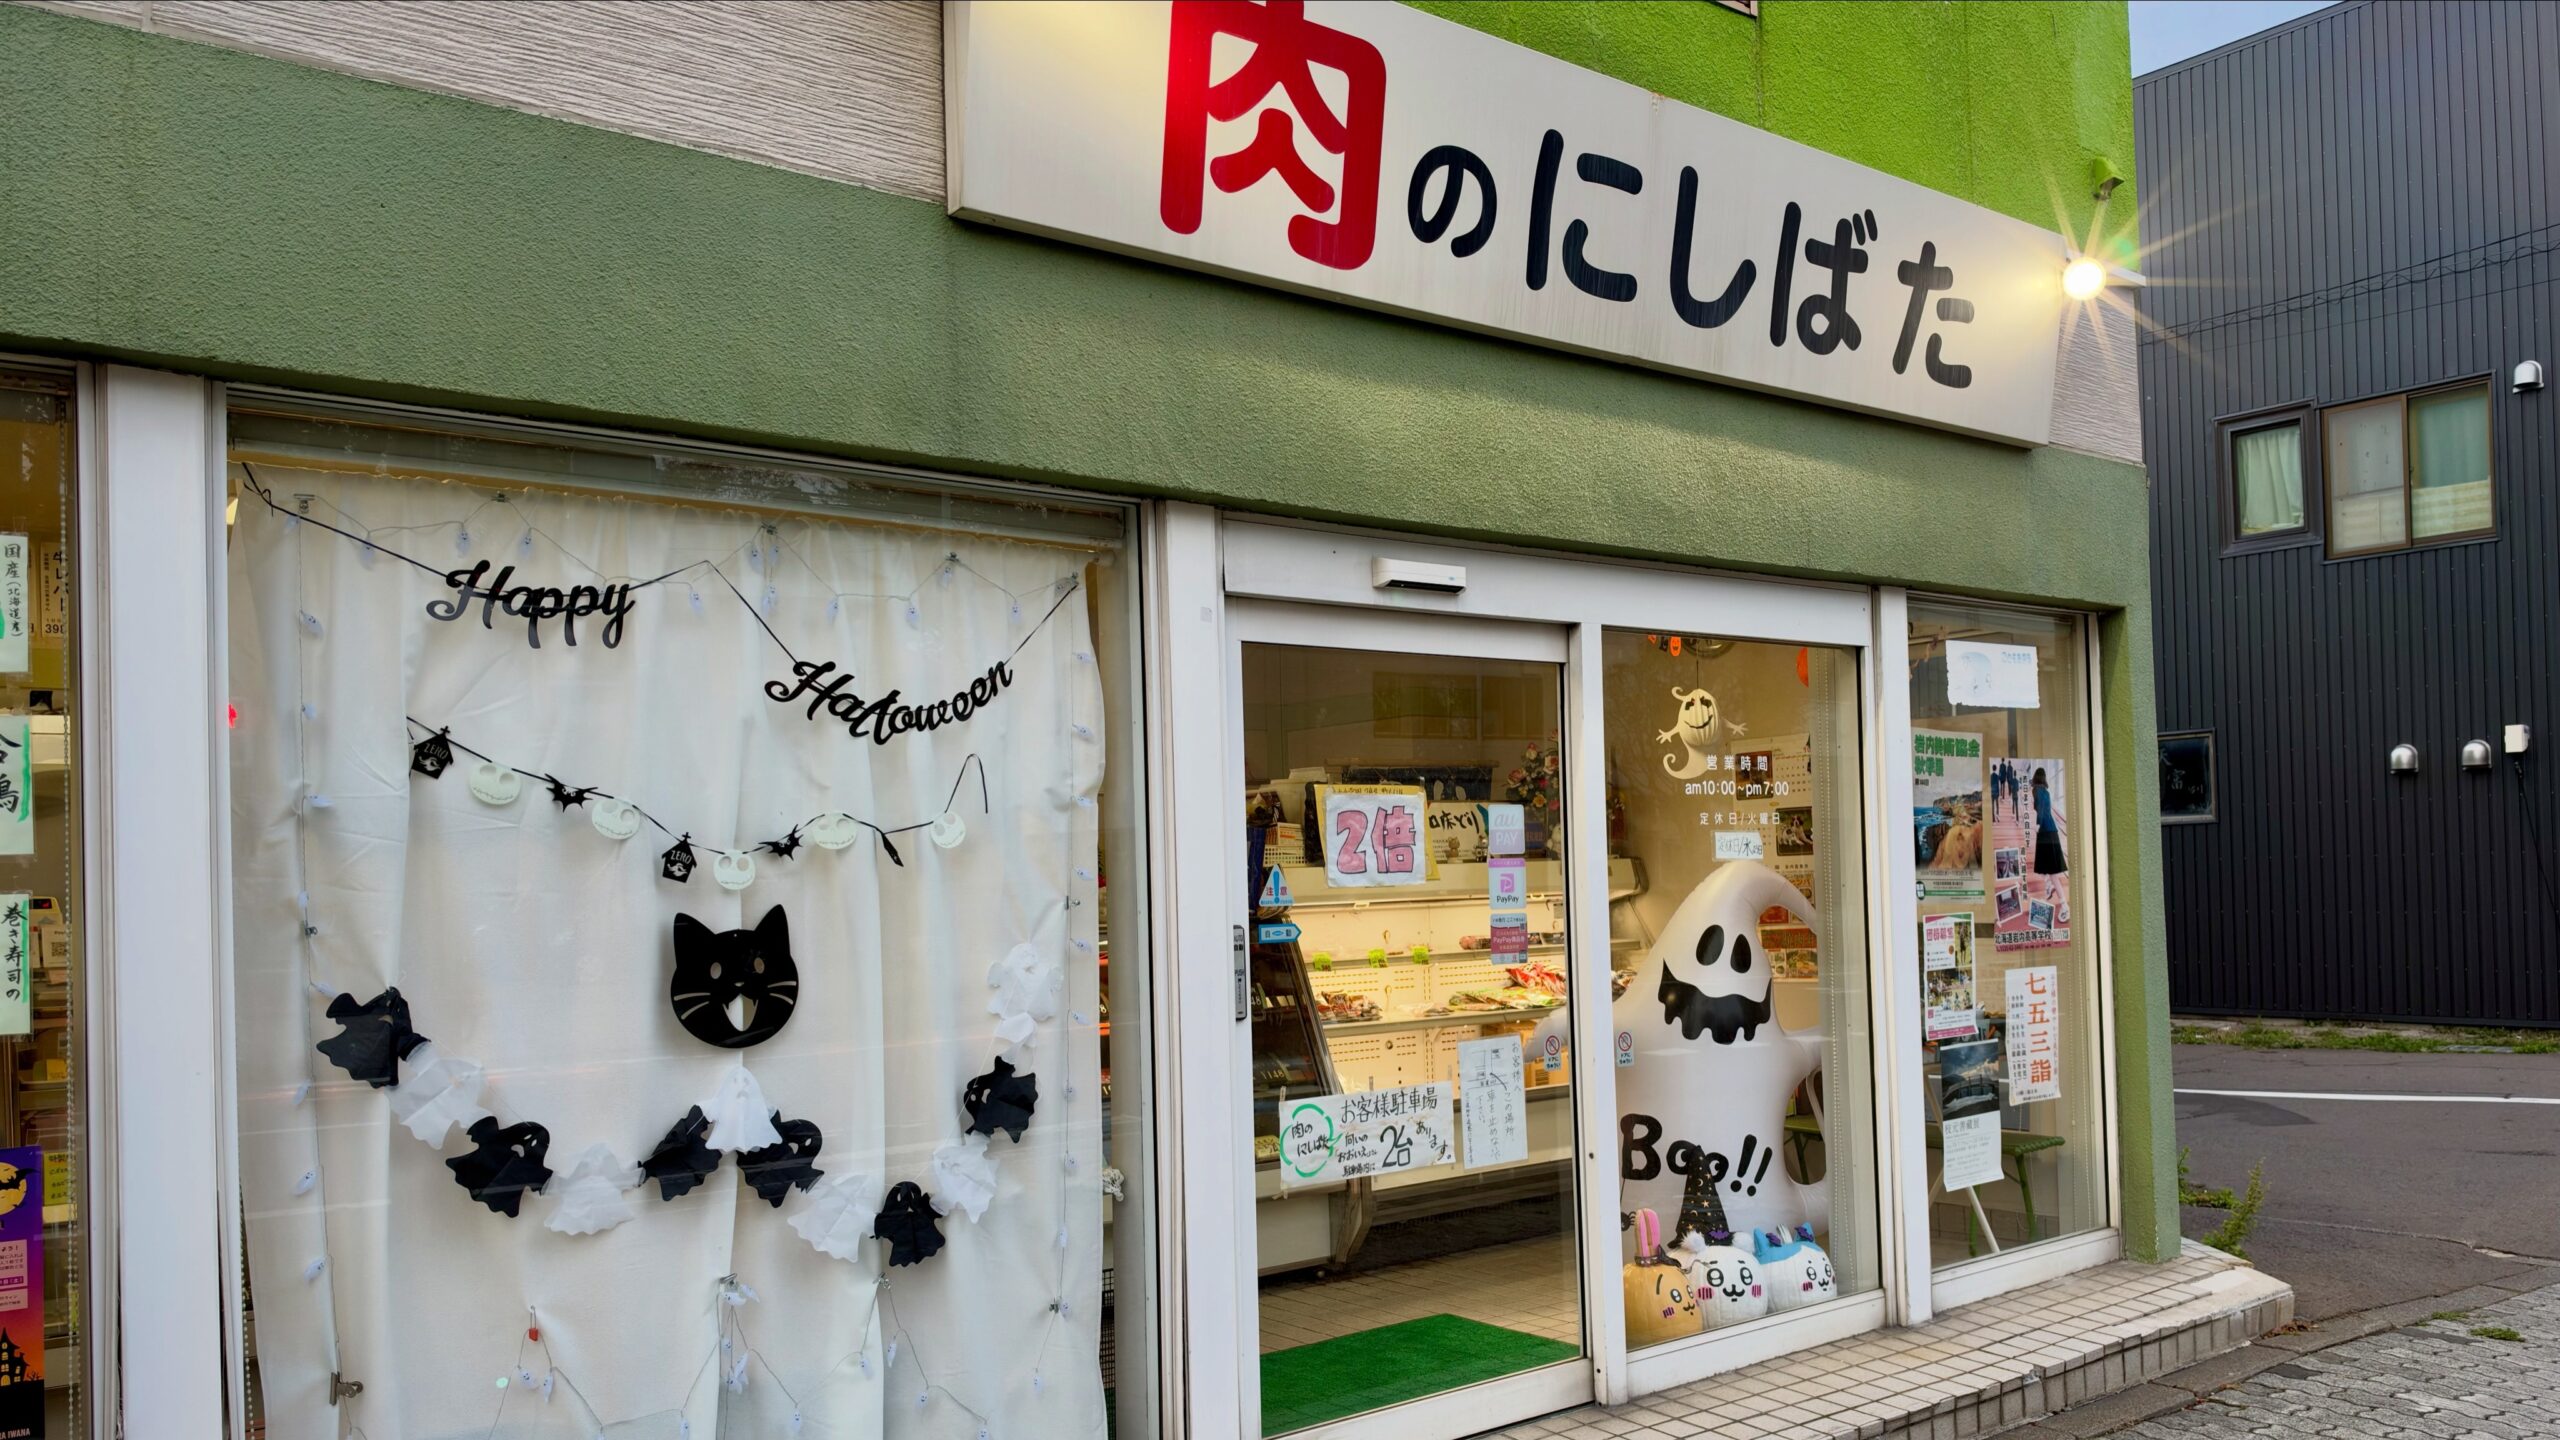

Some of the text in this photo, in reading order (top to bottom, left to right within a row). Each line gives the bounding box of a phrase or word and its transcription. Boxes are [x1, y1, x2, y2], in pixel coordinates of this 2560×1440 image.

[1159, 0, 1975, 389] 肉のにしばた
[425, 558, 636, 649] Happy
[763, 660, 1013, 745] Halloween
[424, 742, 449, 760] ZERO
[1707, 754, 1768, 772] 営業時間
[1336, 805, 1417, 875] 2倍
[1494, 814, 1518, 828] au
[1496, 831, 1519, 847] PAY
[670, 849, 693, 865] ZERO
[1496, 895, 1520, 905] PayPay
[2, 902, 28, 1001] 巻き寿司の
[2025, 972, 2052, 1085] 七五三詣
[1341, 1086, 1438, 1124] お客様駐車場
[1291, 1121, 1313, 1140] 肉の
[1345, 1131, 1369, 1147] 向いの
[1380, 1124, 1413, 1168] 2台
[1620, 1113, 1773, 1197] Boo!!
